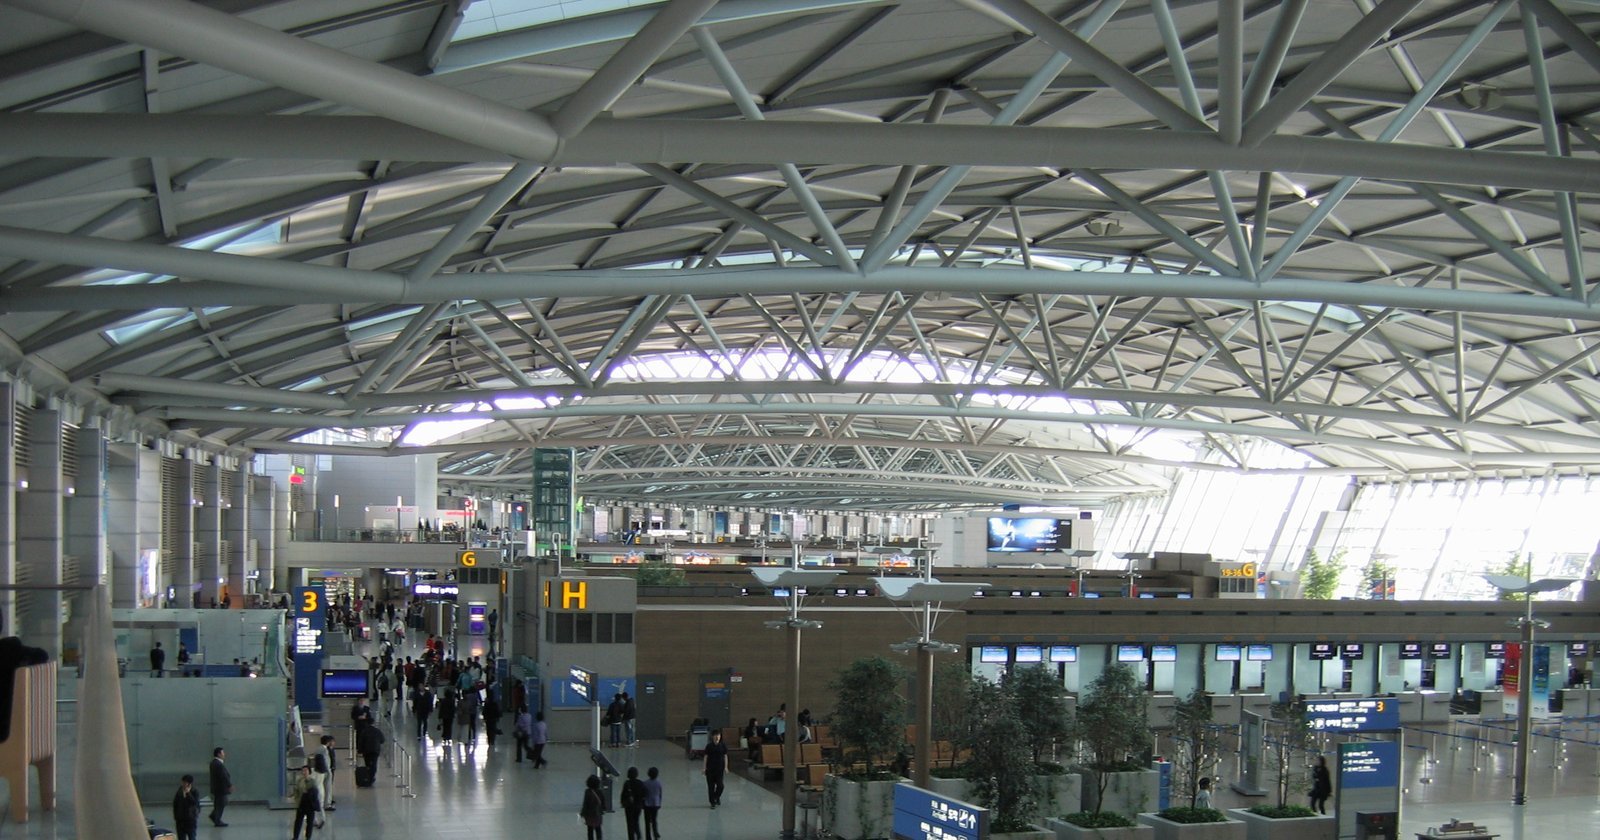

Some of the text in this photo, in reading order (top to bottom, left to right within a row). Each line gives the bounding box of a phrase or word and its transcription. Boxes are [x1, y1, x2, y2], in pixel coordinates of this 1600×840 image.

[462, 551, 477, 567] G
[1242, 563, 1254, 577] G
[302, 590, 319, 613] 3
[562, 581, 587, 610] H
[1376, 701, 1384, 712] 3
